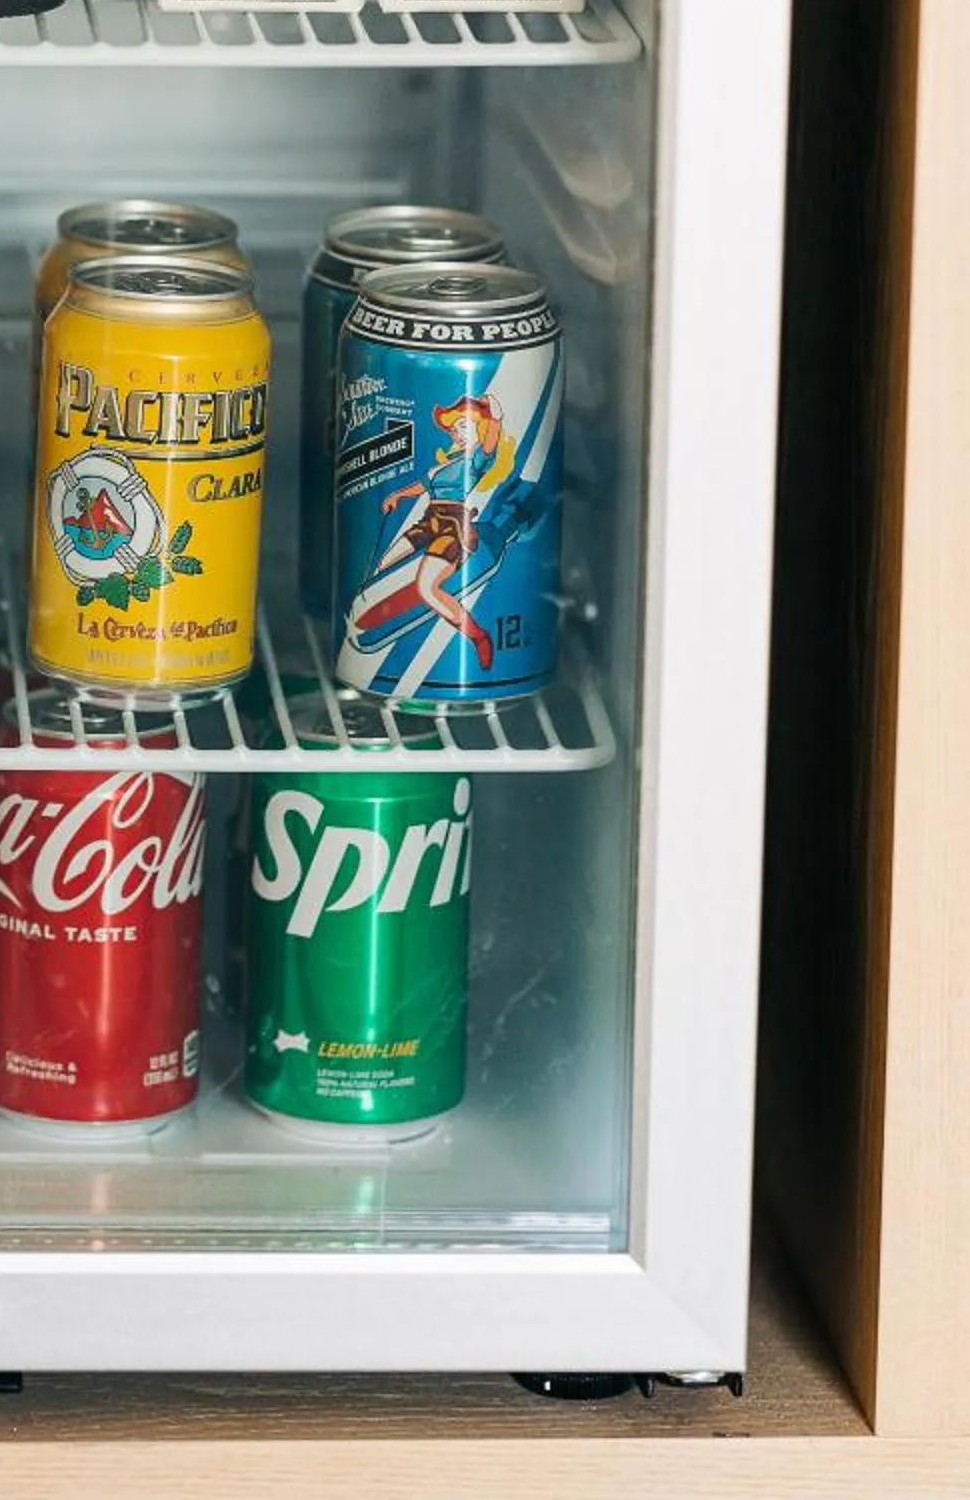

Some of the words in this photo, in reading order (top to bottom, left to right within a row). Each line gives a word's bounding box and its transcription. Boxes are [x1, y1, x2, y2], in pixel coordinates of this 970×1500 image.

[352, 307, 404, 336] BEER
[411, 325, 475, 341] FOR
[369, 437, 407, 462] BLONDE
[399, 461, 415, 474] ALE
[187, 468, 261, 502] CLARA
[77, 612, 99, 638] La
[104, 616, 167, 642] Cerveza
[63, 926, 137, 942] TASTE
[318, 1038, 420, 1059] LEMON-LIME
